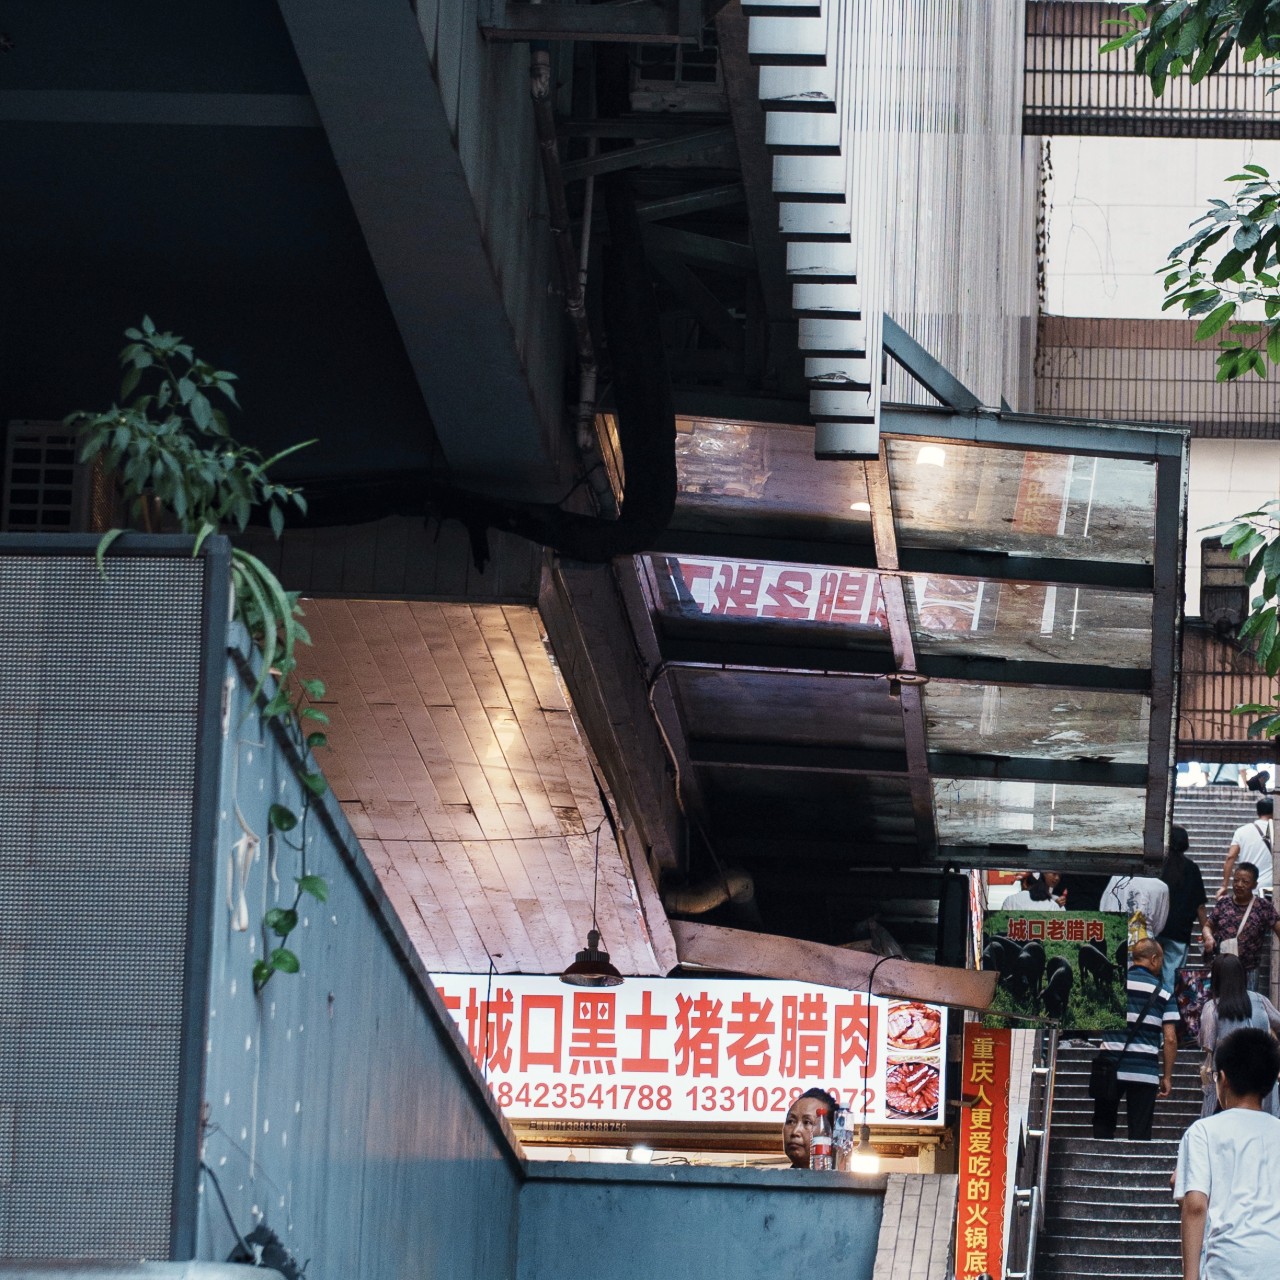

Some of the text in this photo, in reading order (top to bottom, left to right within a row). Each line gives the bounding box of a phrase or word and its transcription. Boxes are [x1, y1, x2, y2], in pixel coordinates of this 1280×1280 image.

[1008, 918, 1104, 942] 城口老腊肉
